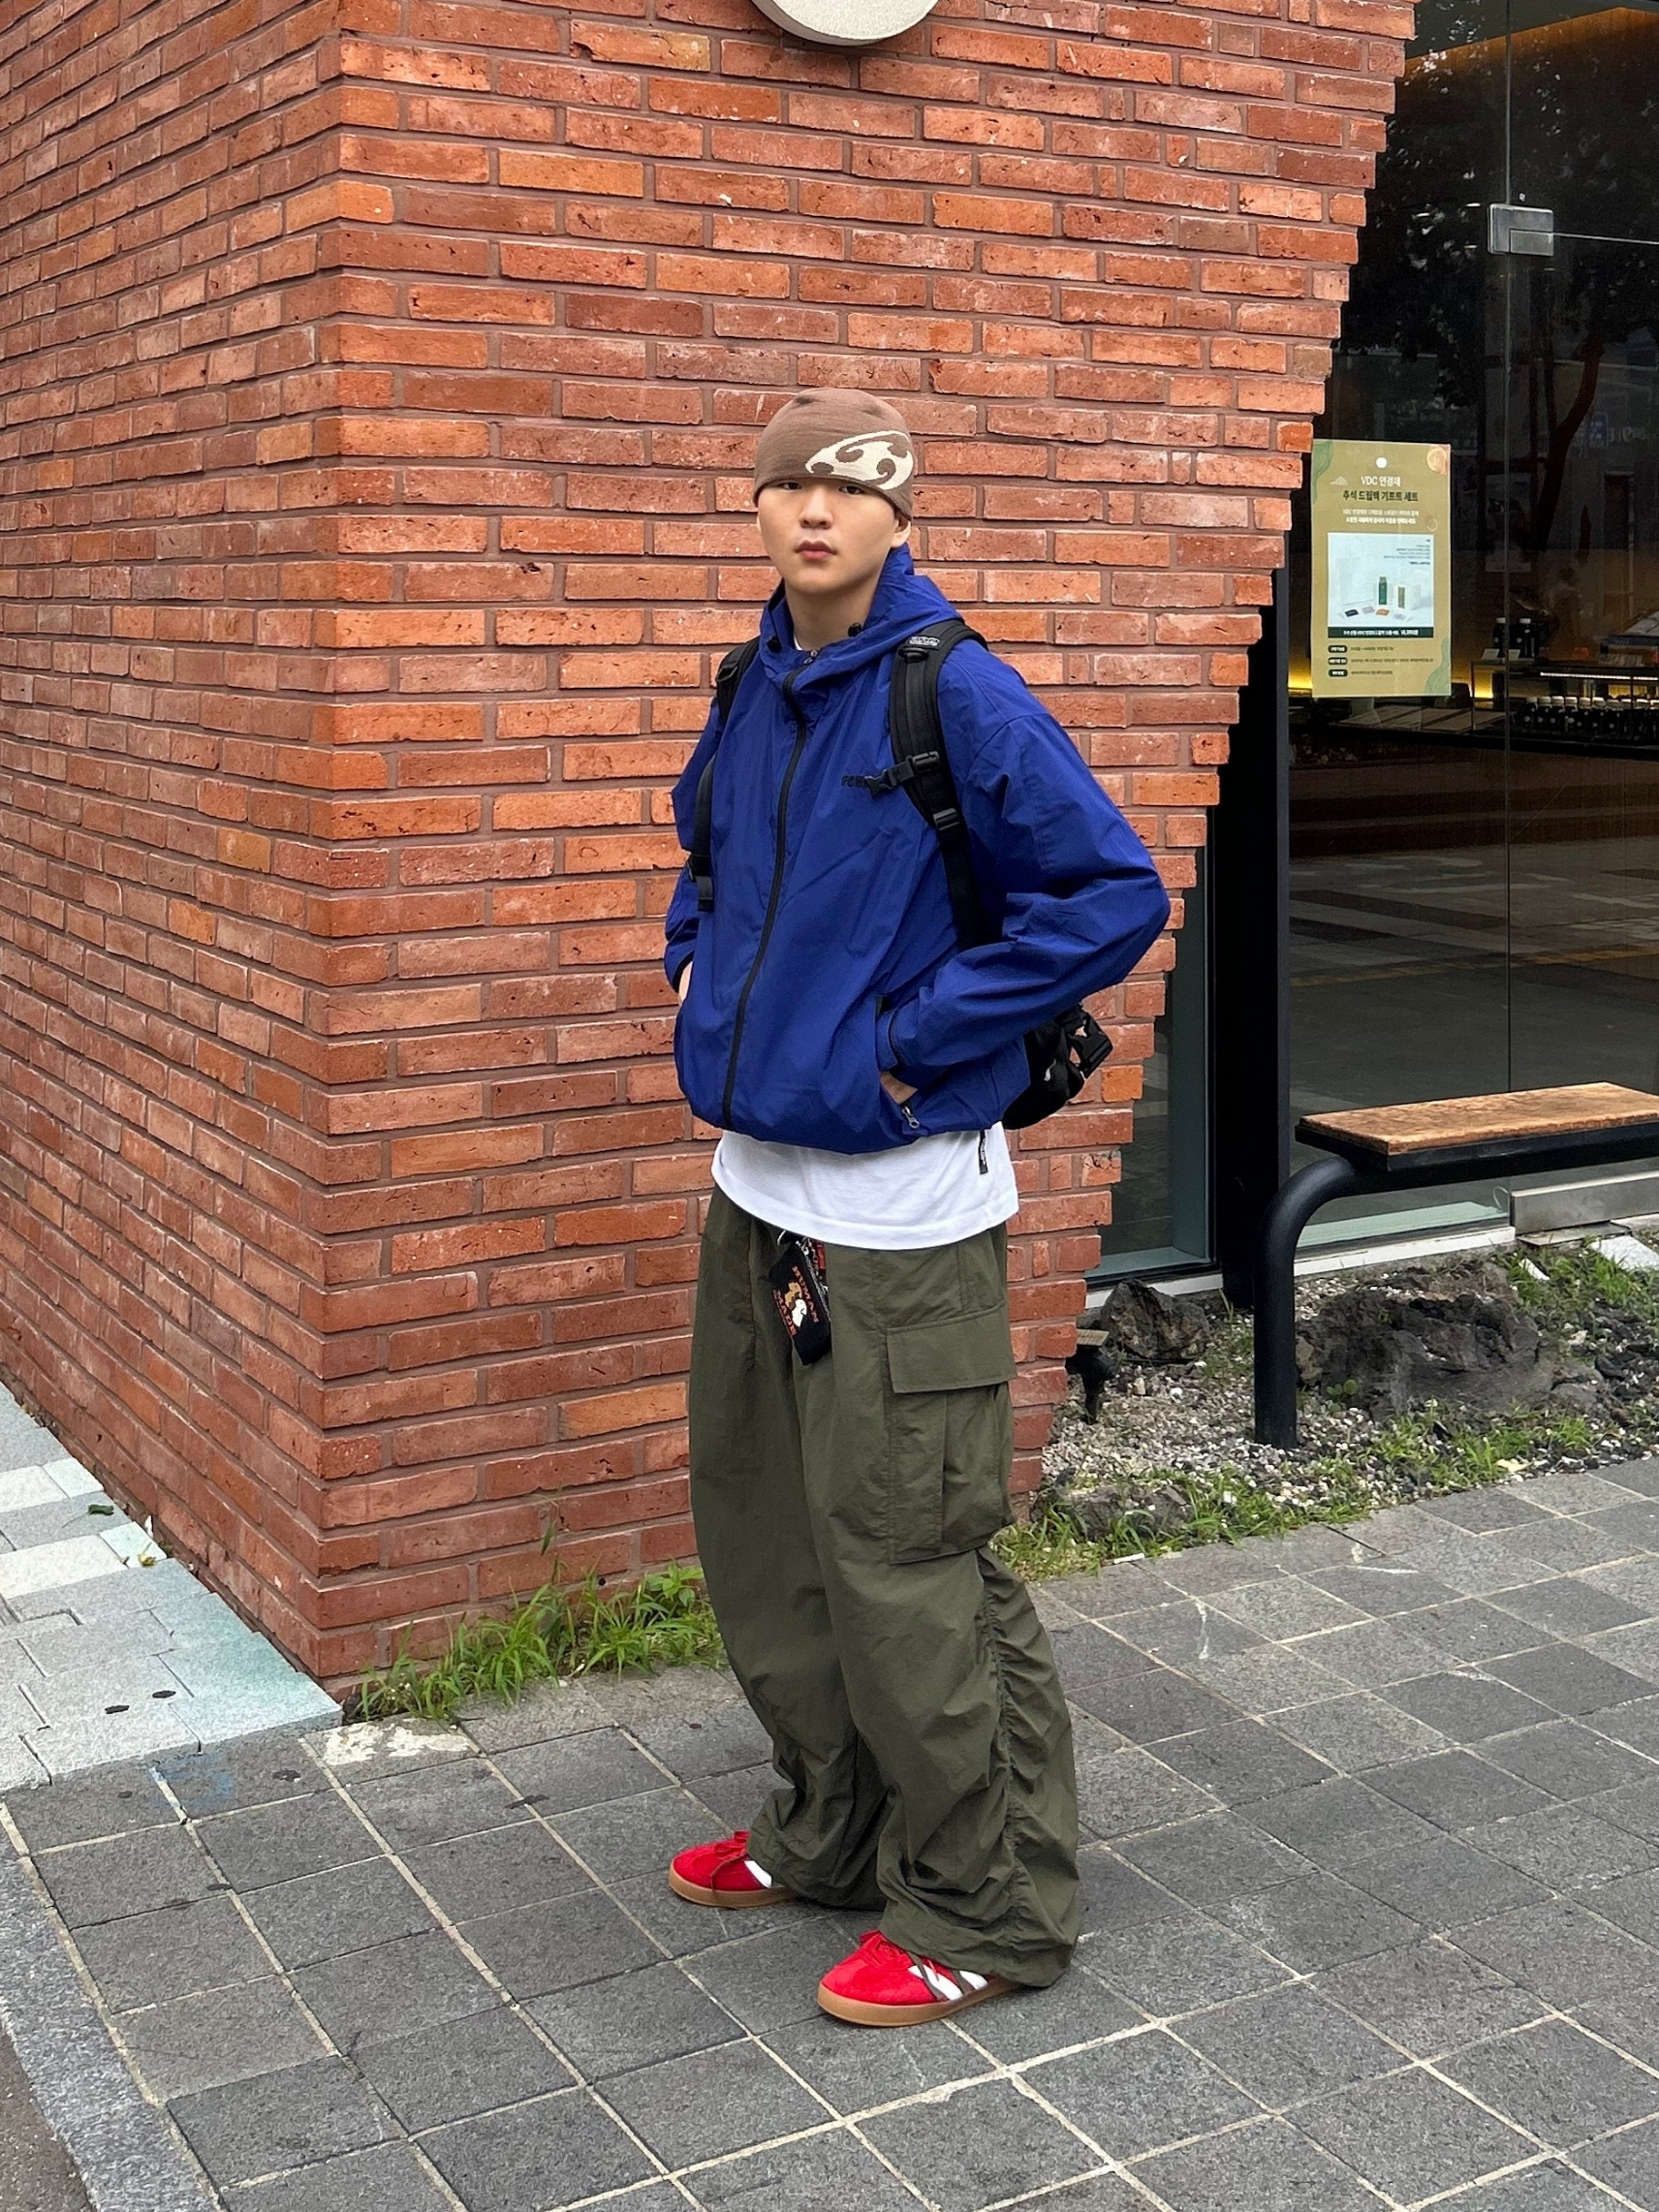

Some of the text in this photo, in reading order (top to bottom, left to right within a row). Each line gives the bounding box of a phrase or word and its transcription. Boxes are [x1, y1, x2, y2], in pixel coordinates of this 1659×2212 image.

[1343, 489, 1419, 502] 추석 드립백 기프트 세트
[1361, 476, 1401, 487] VDC 연경재
[792, 1265, 819, 1323] HUMAN
[773, 1289, 797, 1335] MADE
